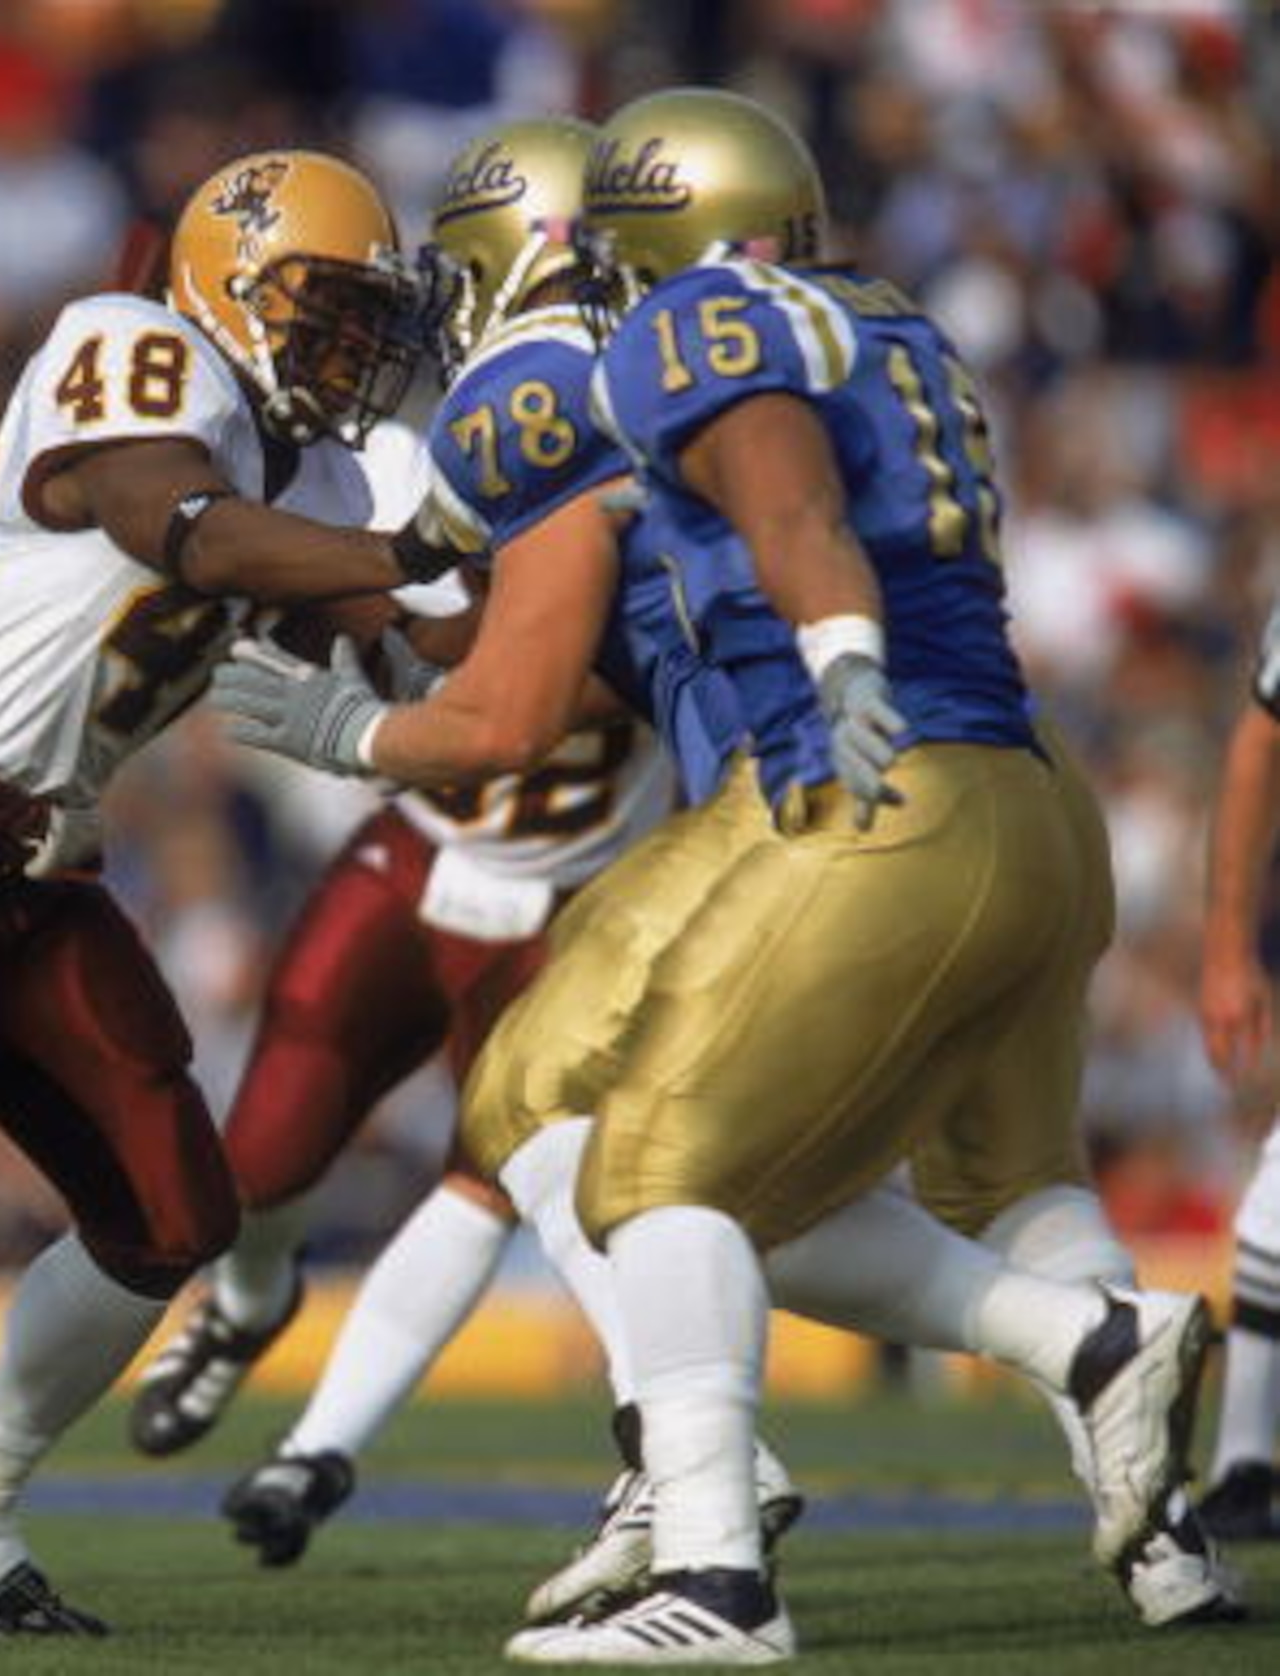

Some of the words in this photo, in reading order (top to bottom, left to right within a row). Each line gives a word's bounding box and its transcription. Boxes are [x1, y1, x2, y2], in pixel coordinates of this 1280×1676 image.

[55, 332, 191, 424] 48
[650, 296, 760, 393] 15
[450, 381, 576, 498] 78
